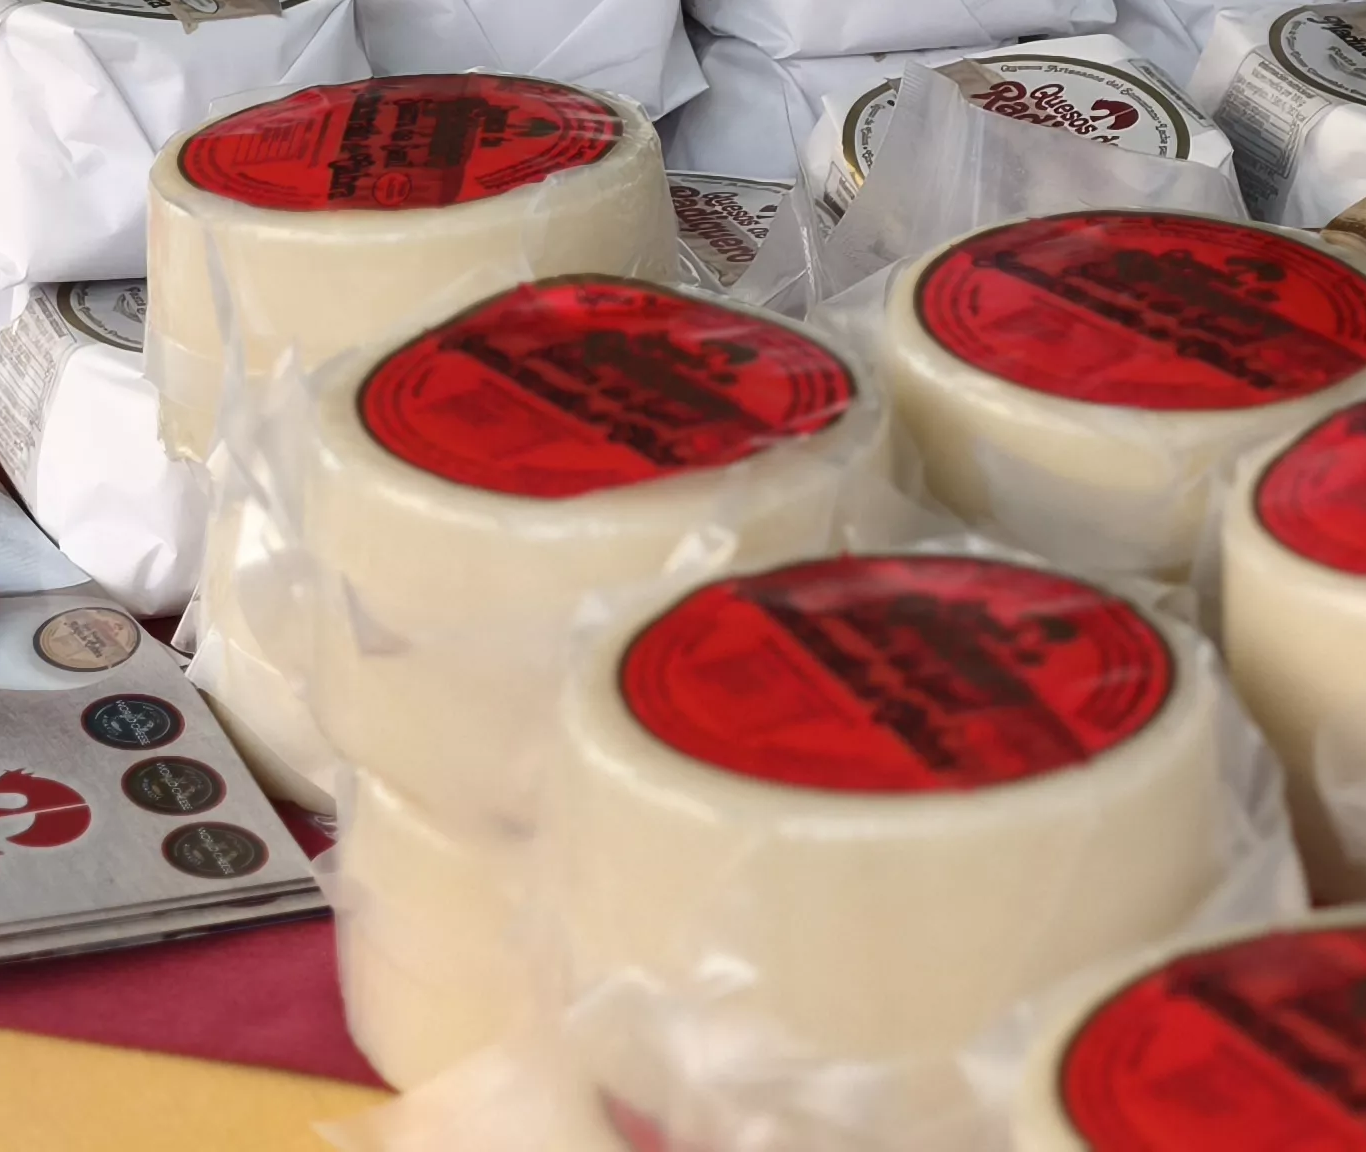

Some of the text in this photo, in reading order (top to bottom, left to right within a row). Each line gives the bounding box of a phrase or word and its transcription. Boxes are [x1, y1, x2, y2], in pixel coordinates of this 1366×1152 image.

[1044, 64, 1105, 83] Artesanos
[1106, 79, 1123, 95] del
[1030, 83, 1098, 135] Quesos
[703, 192, 760, 226] Quesos
